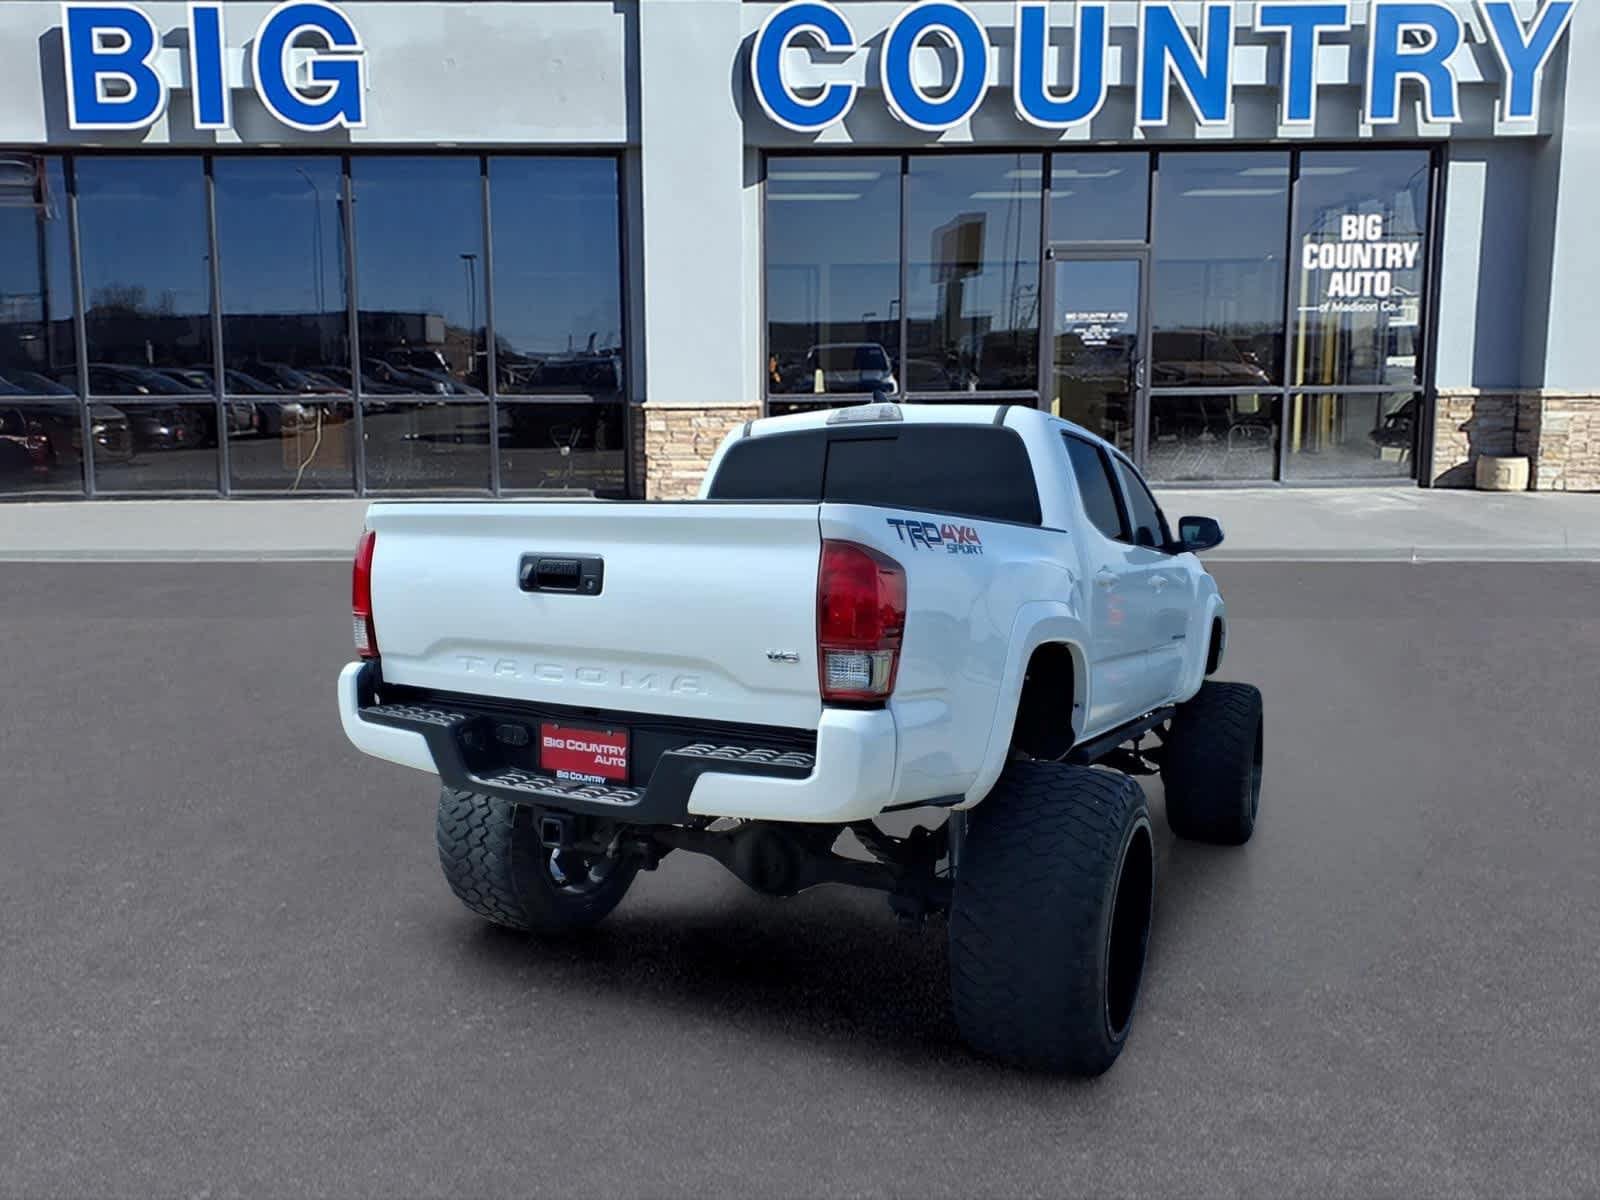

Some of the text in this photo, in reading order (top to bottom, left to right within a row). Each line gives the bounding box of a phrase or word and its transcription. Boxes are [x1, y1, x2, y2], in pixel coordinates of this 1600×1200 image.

[62, 0, 1574, 134] BIG COUNTRY
[1341, 214, 1382, 241] BIG
[1302, 243, 1419, 269] COUNTRY
[1327, 271, 1392, 298] AUTO
[1318, 302, 1330, 313] of
[1331, 301, 1378, 313] Madison
[886, 518, 942, 550] TRD
[946, 543, 984, 555] SPORT
[456, 655, 712, 696] TACOMA
[566, 739, 626, 756] COUNTRY
[594, 755, 626, 767] AUTO
